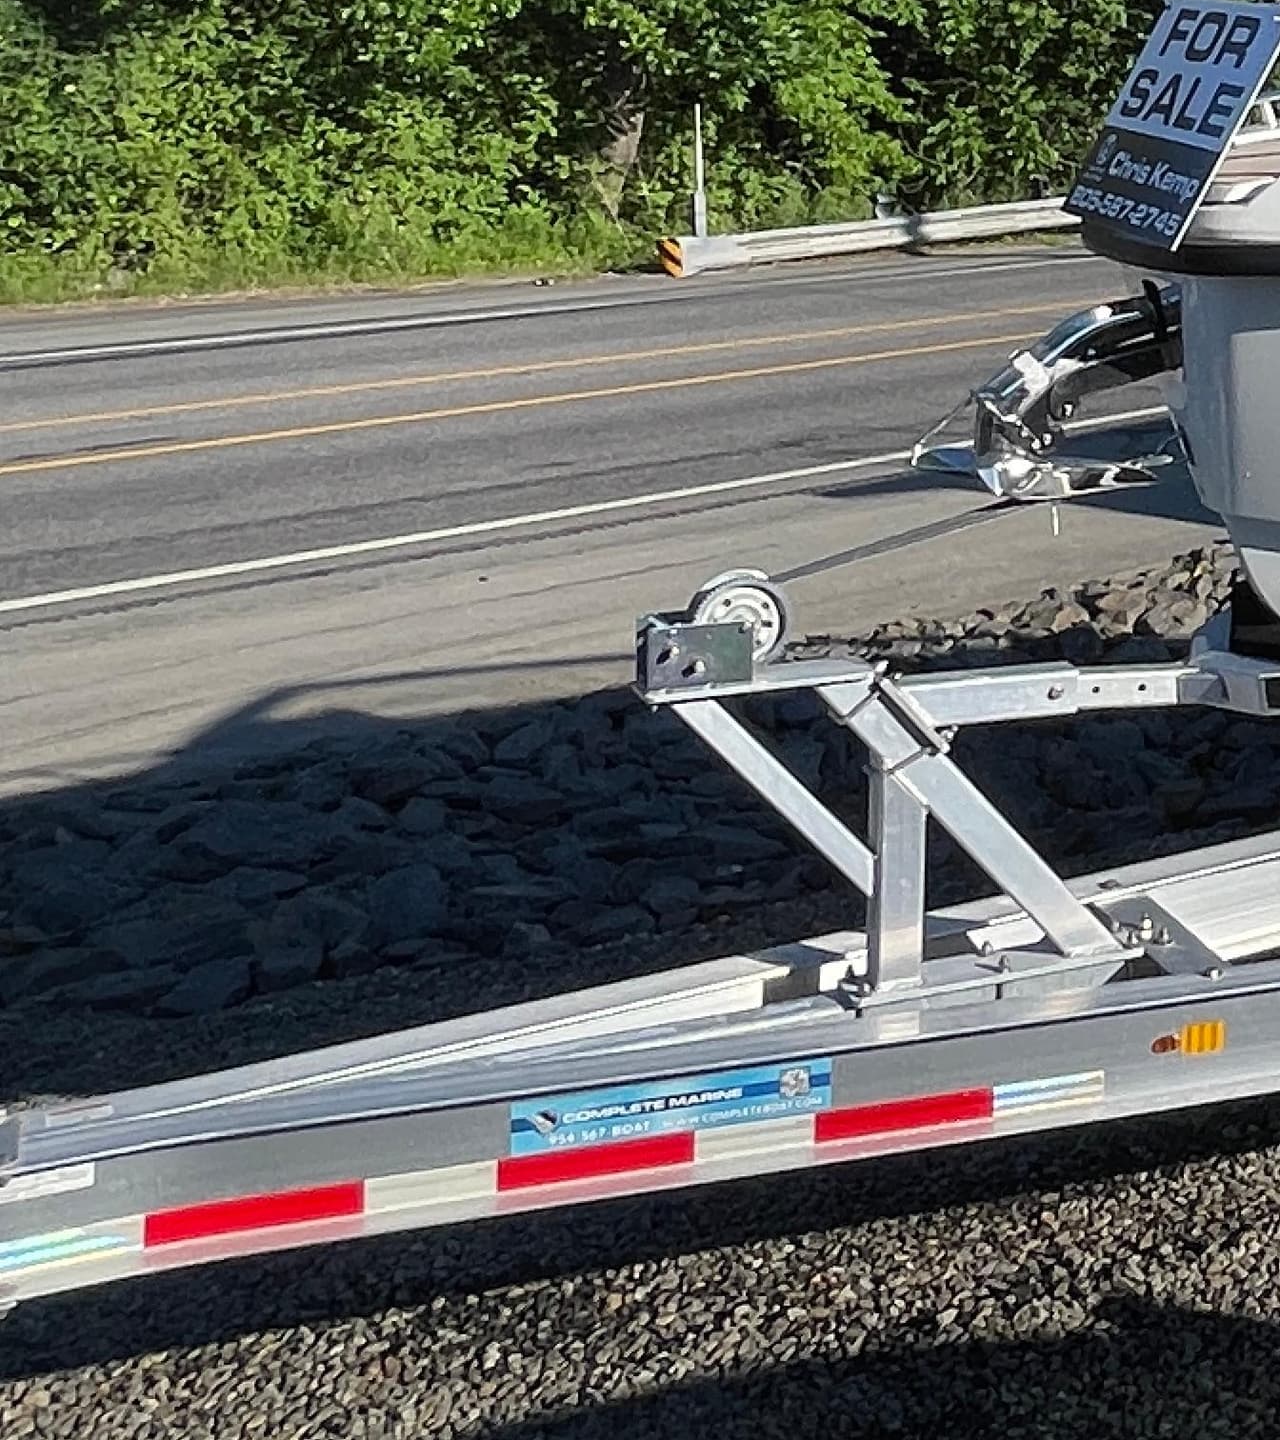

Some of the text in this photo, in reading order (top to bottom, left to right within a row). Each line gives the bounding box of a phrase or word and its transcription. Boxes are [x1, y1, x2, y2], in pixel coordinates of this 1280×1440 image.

[1159, 9, 1261, 68] FOR
[1120, 69, 1245, 139] SALE
[1107, 151, 1151, 185] Chris
[1148, 159, 1200, 204] Kemp
[562, 1087, 743, 1124] COMPLETE MARINE
[611, 1120, 650, 1138] BOAT
